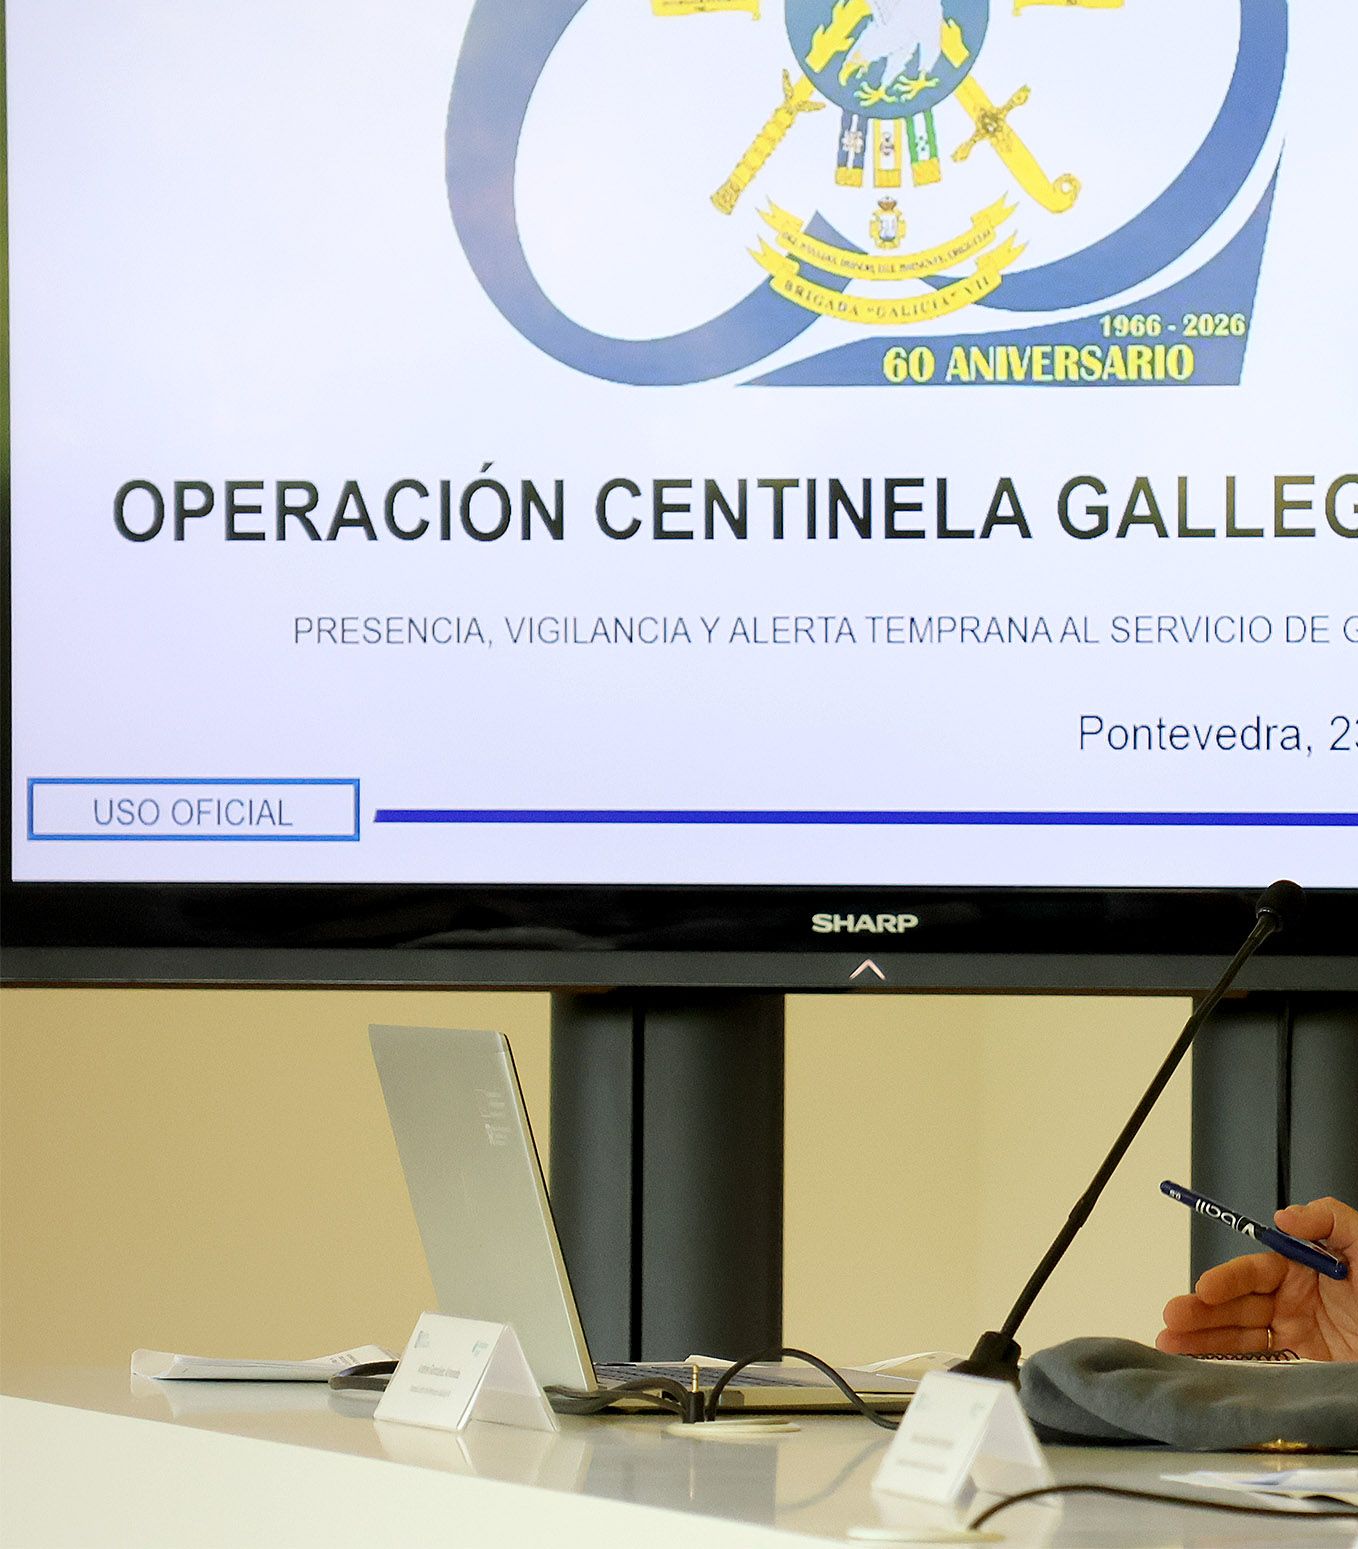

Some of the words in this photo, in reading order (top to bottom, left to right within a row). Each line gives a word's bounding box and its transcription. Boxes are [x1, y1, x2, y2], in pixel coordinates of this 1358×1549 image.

[784, 279, 859, 317] BRIGADA
[1101, 313, 1161, 337] 1966
[1183, 313, 1243, 337] 2026
[883, 345, 936, 384] 60
[945, 343, 1195, 384] ANIVERSARIO
[113, 462, 565, 543] OPERACIÓN
[595, 477, 1033, 541] CENTINELA
[293, 616, 493, 648] PRESENCIA,
[504, 616, 692, 644] VIGILANCIA
[700, 616, 720, 644] Y
[729, 616, 857, 644] ALERTA
[865, 615, 1053, 644] TEMPRANA
[1058, 615, 1100, 644] AL
[1110, 615, 1273, 644] SERVICIO
[1284, 615, 1330, 644] DE
[1080, 715, 1312, 758] Pontevedra,
[93, 798, 160, 826] USO
[171, 798, 294, 827] OFICIAL
[811, 913, 919, 933] SHARP
